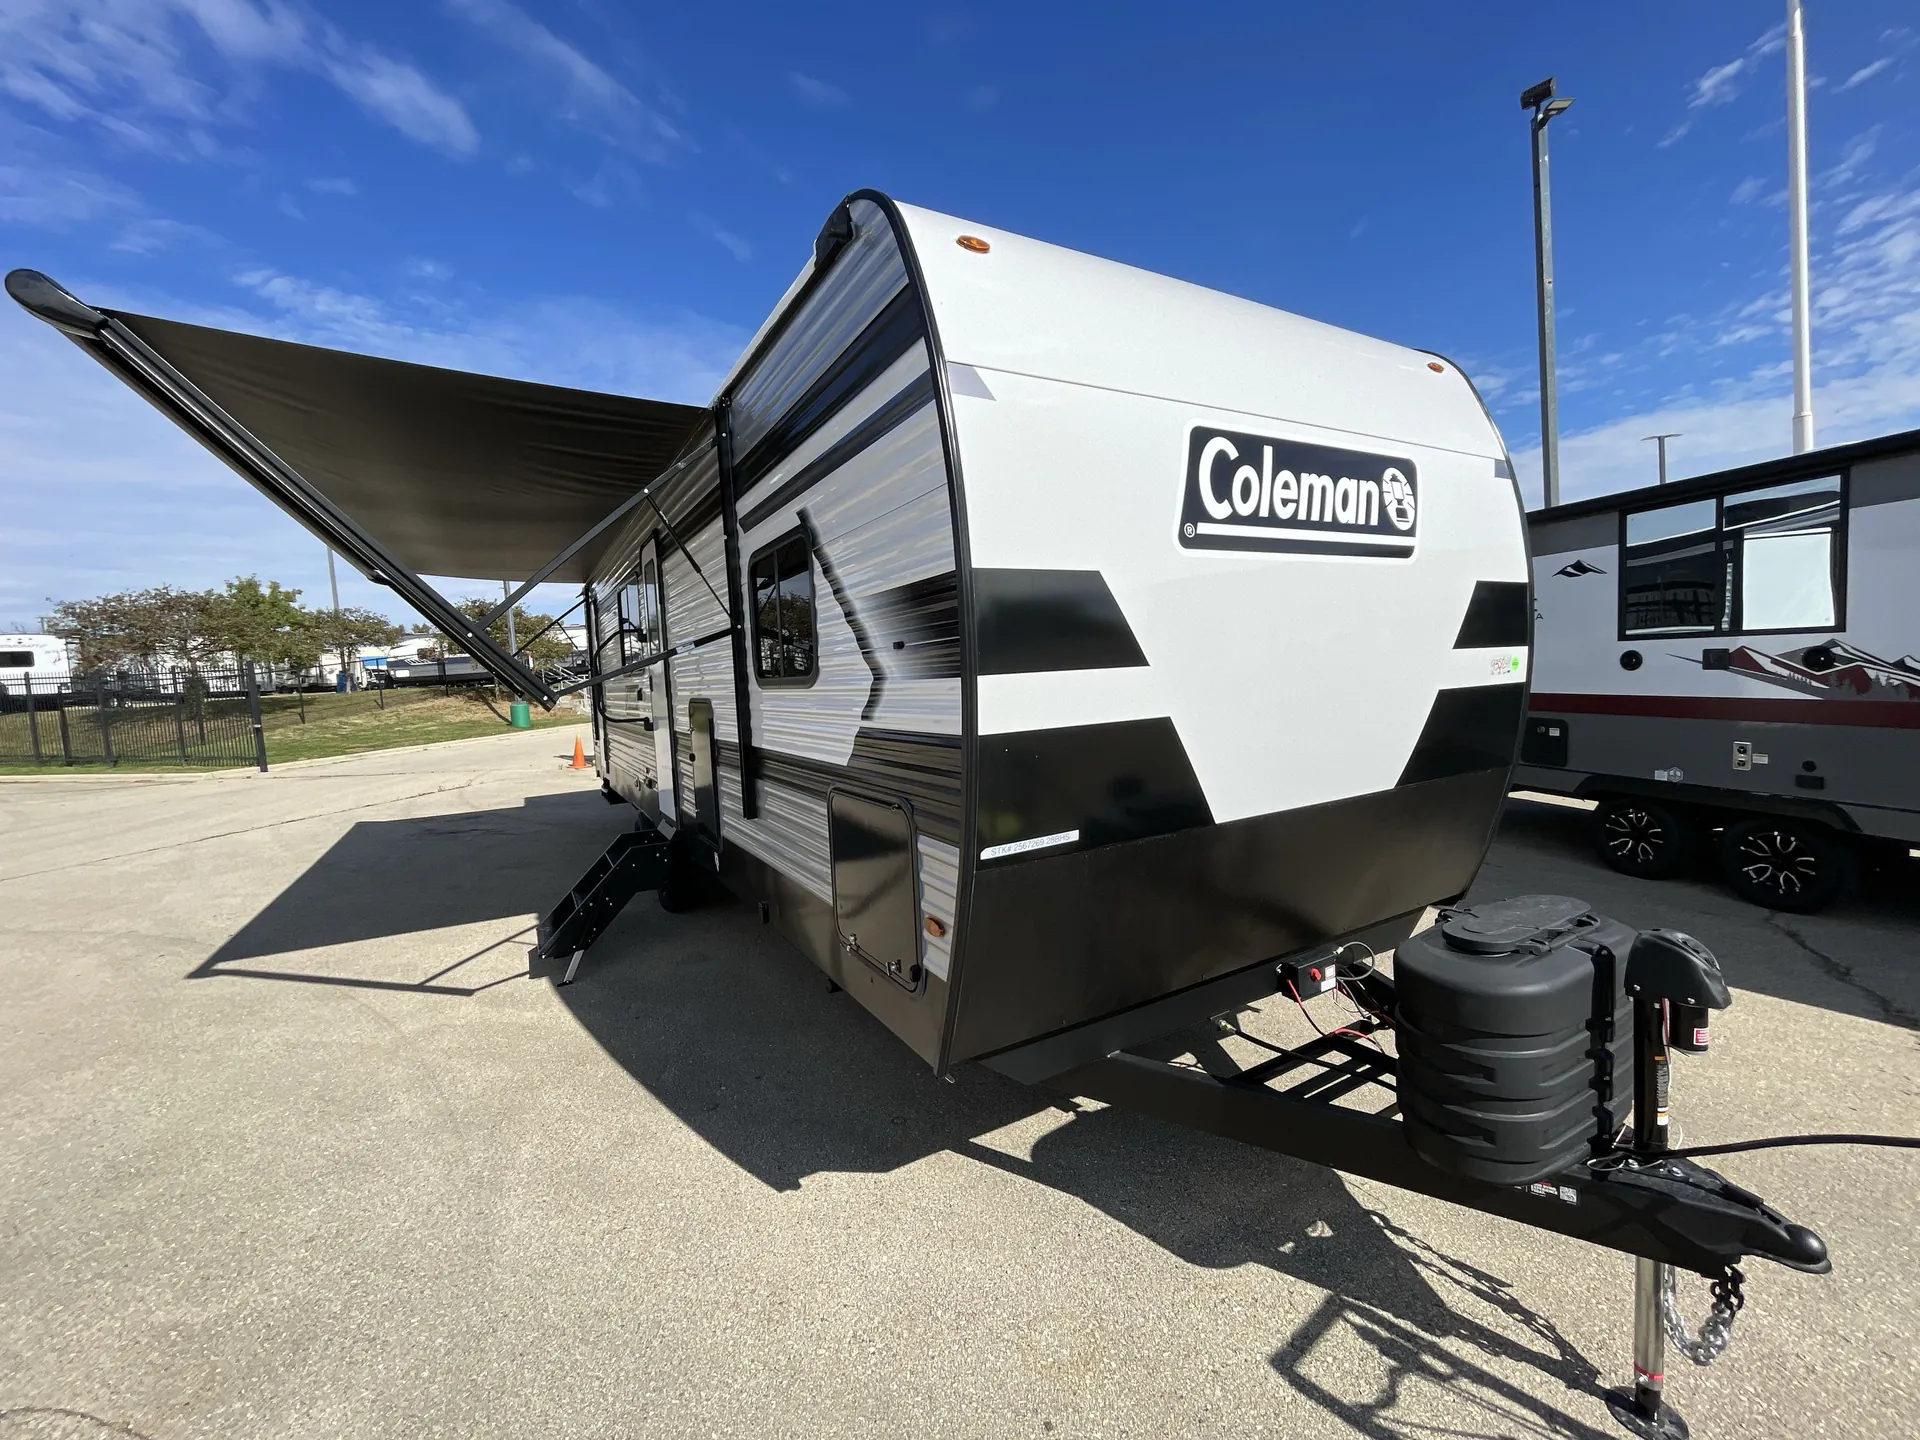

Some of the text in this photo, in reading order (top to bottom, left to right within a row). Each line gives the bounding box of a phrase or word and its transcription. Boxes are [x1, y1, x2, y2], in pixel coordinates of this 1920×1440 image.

[1199, 436, 1380, 526] Coleman
[990, 833, 1070, 856] STK# 2567269 28BHS
